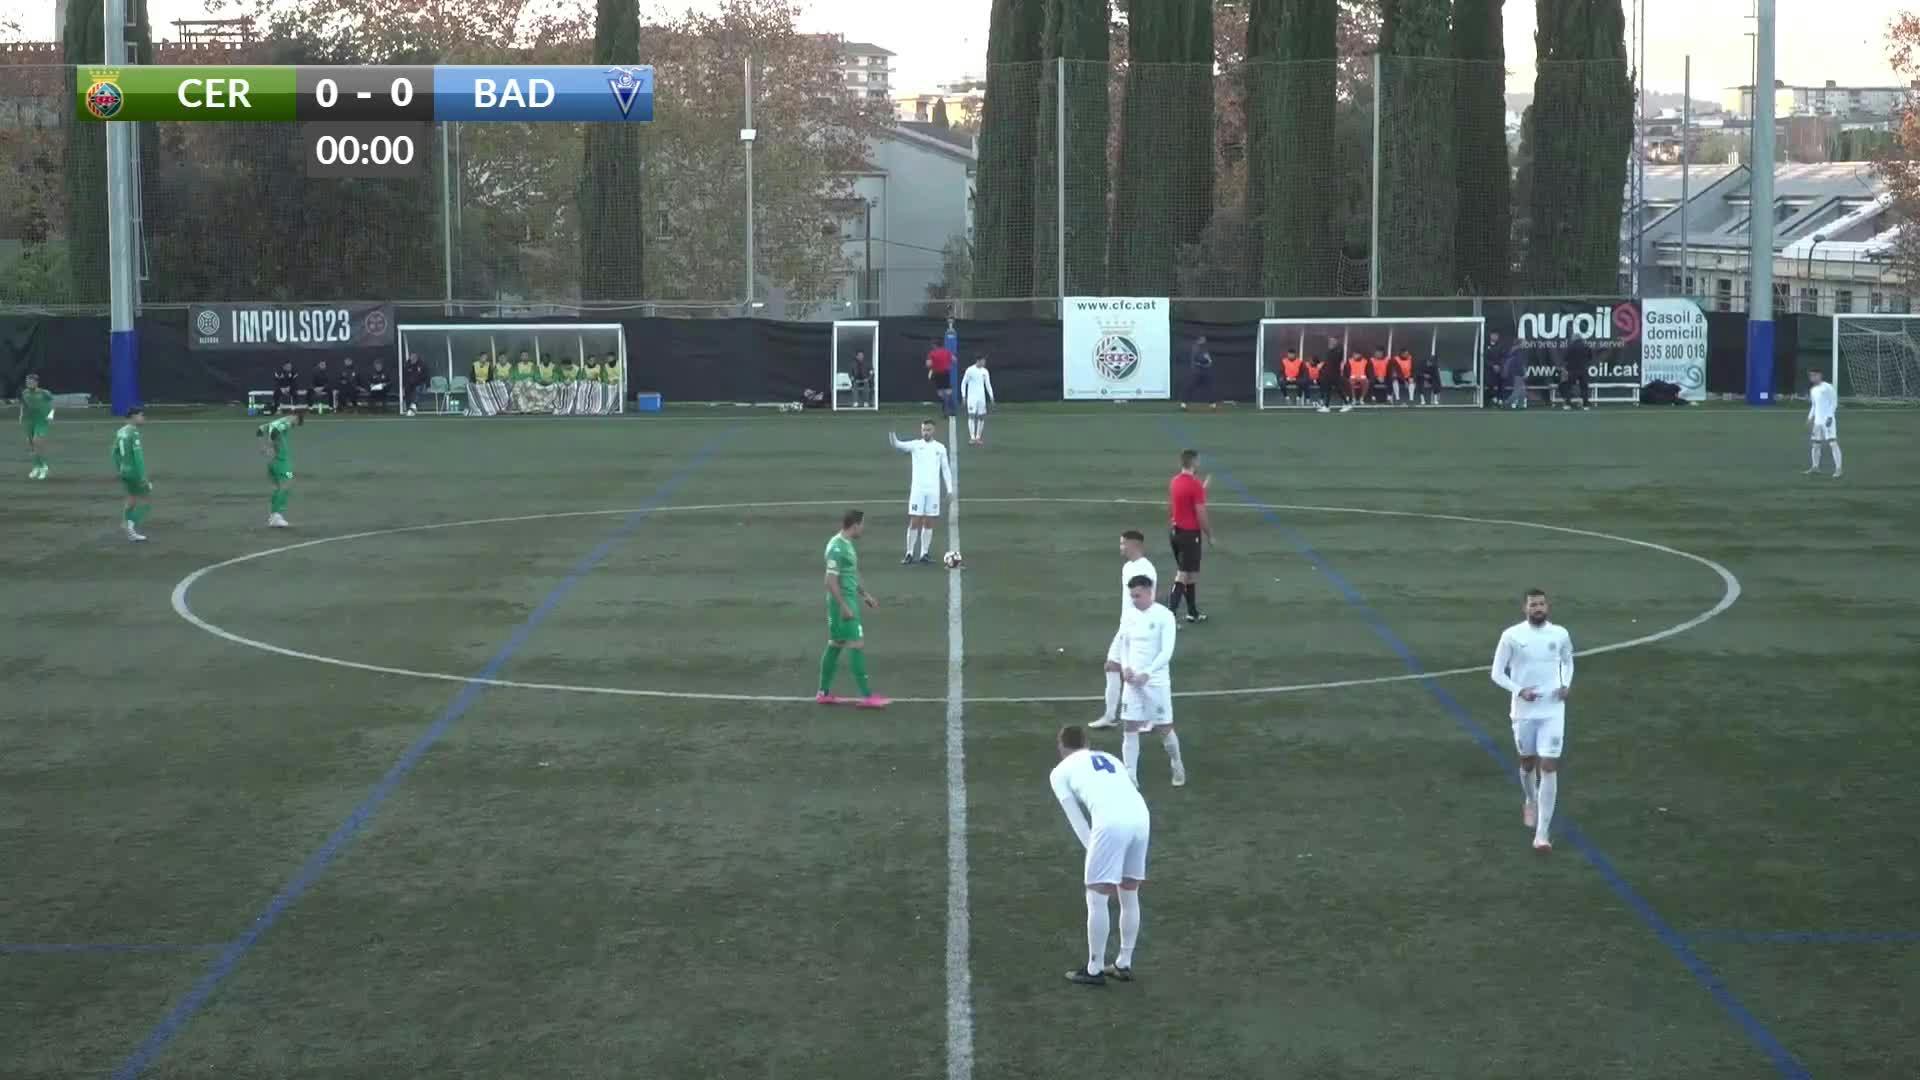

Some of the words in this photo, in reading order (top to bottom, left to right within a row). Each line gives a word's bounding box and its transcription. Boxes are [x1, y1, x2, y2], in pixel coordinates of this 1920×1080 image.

[1077, 300, 1156, 310] www.cfc.cat
[1517, 306, 1611, 339] nuroil
[1646, 310, 1690, 324] Gasoil
[1695, 313, 1703, 324] a
[231, 309, 351, 343] IMPULSO23
[1643, 344, 1662, 359] 935
[1665, 344, 1683, 359] 800
[1687, 344, 1705, 359] 018
[1091, 755, 1116, 774] 4
